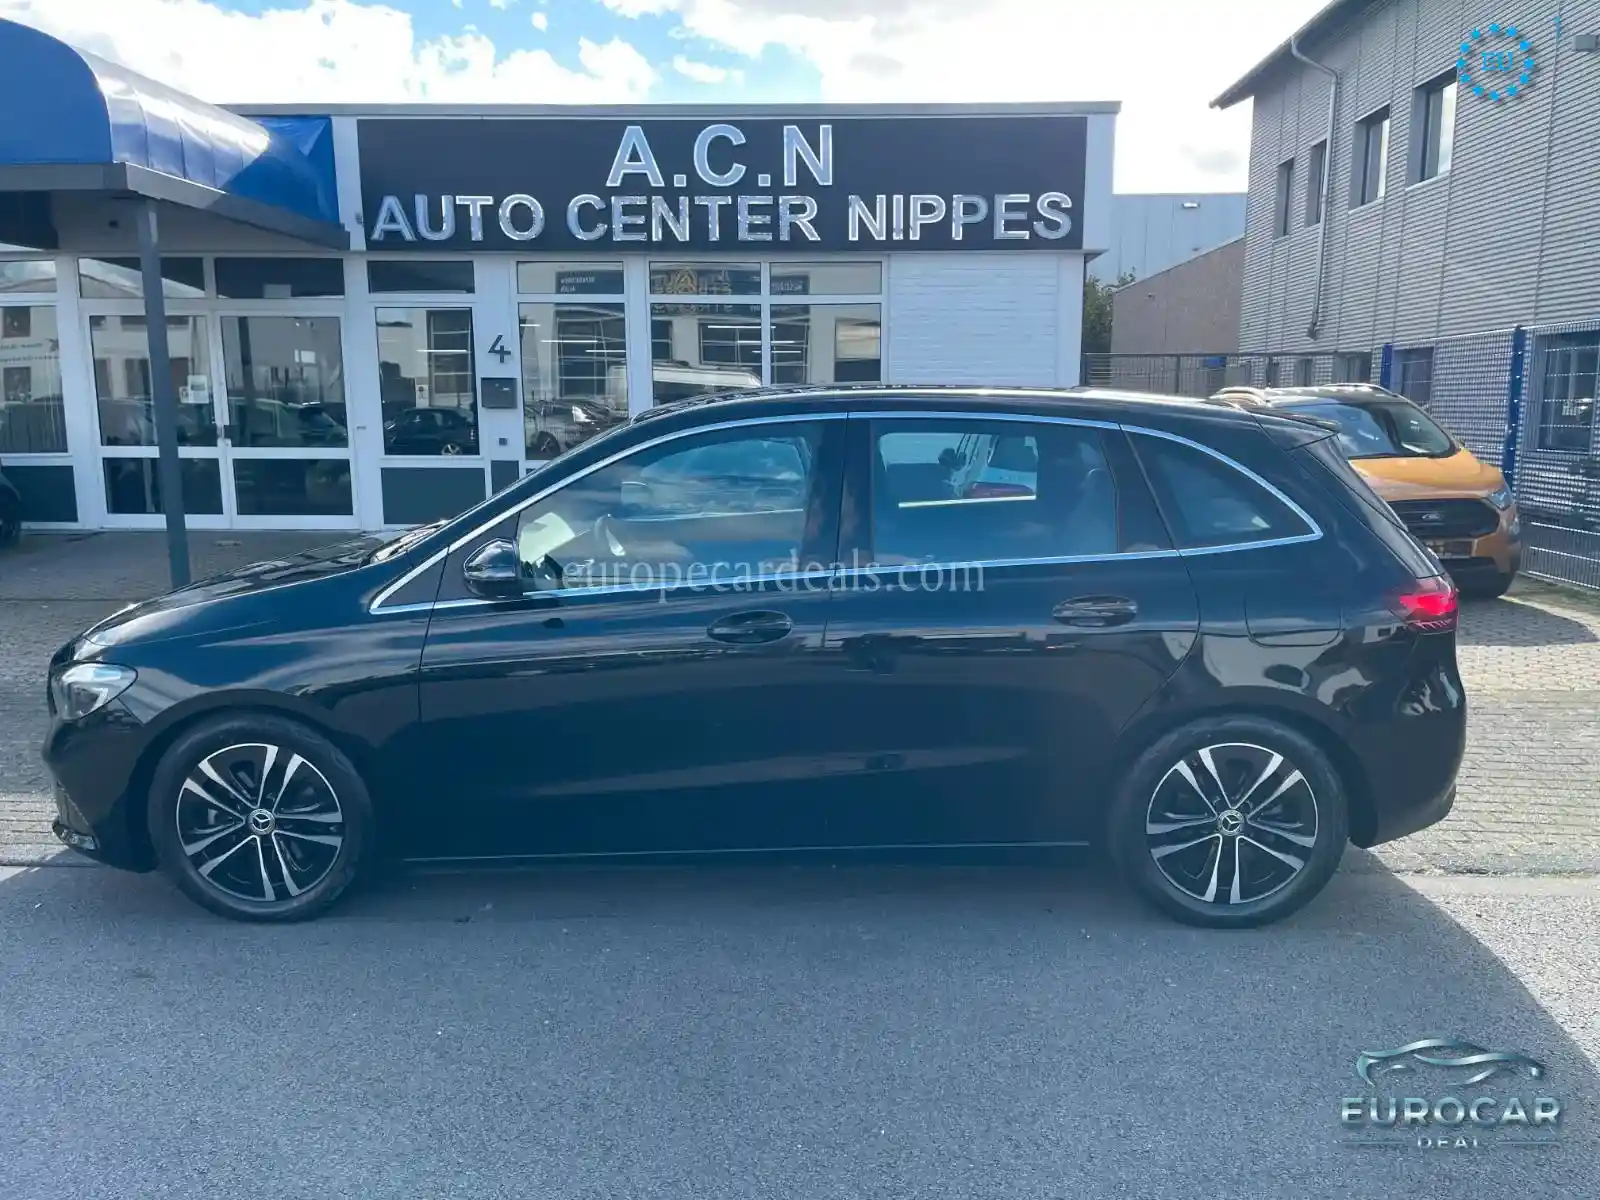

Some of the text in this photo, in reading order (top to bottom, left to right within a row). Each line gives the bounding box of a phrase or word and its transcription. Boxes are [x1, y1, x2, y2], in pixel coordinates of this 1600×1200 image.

[605, 124, 834, 188] A.C.N
[370, 192, 1073, 243] AUTO CENTER NIPPES
[488, 334, 511, 363] 4
